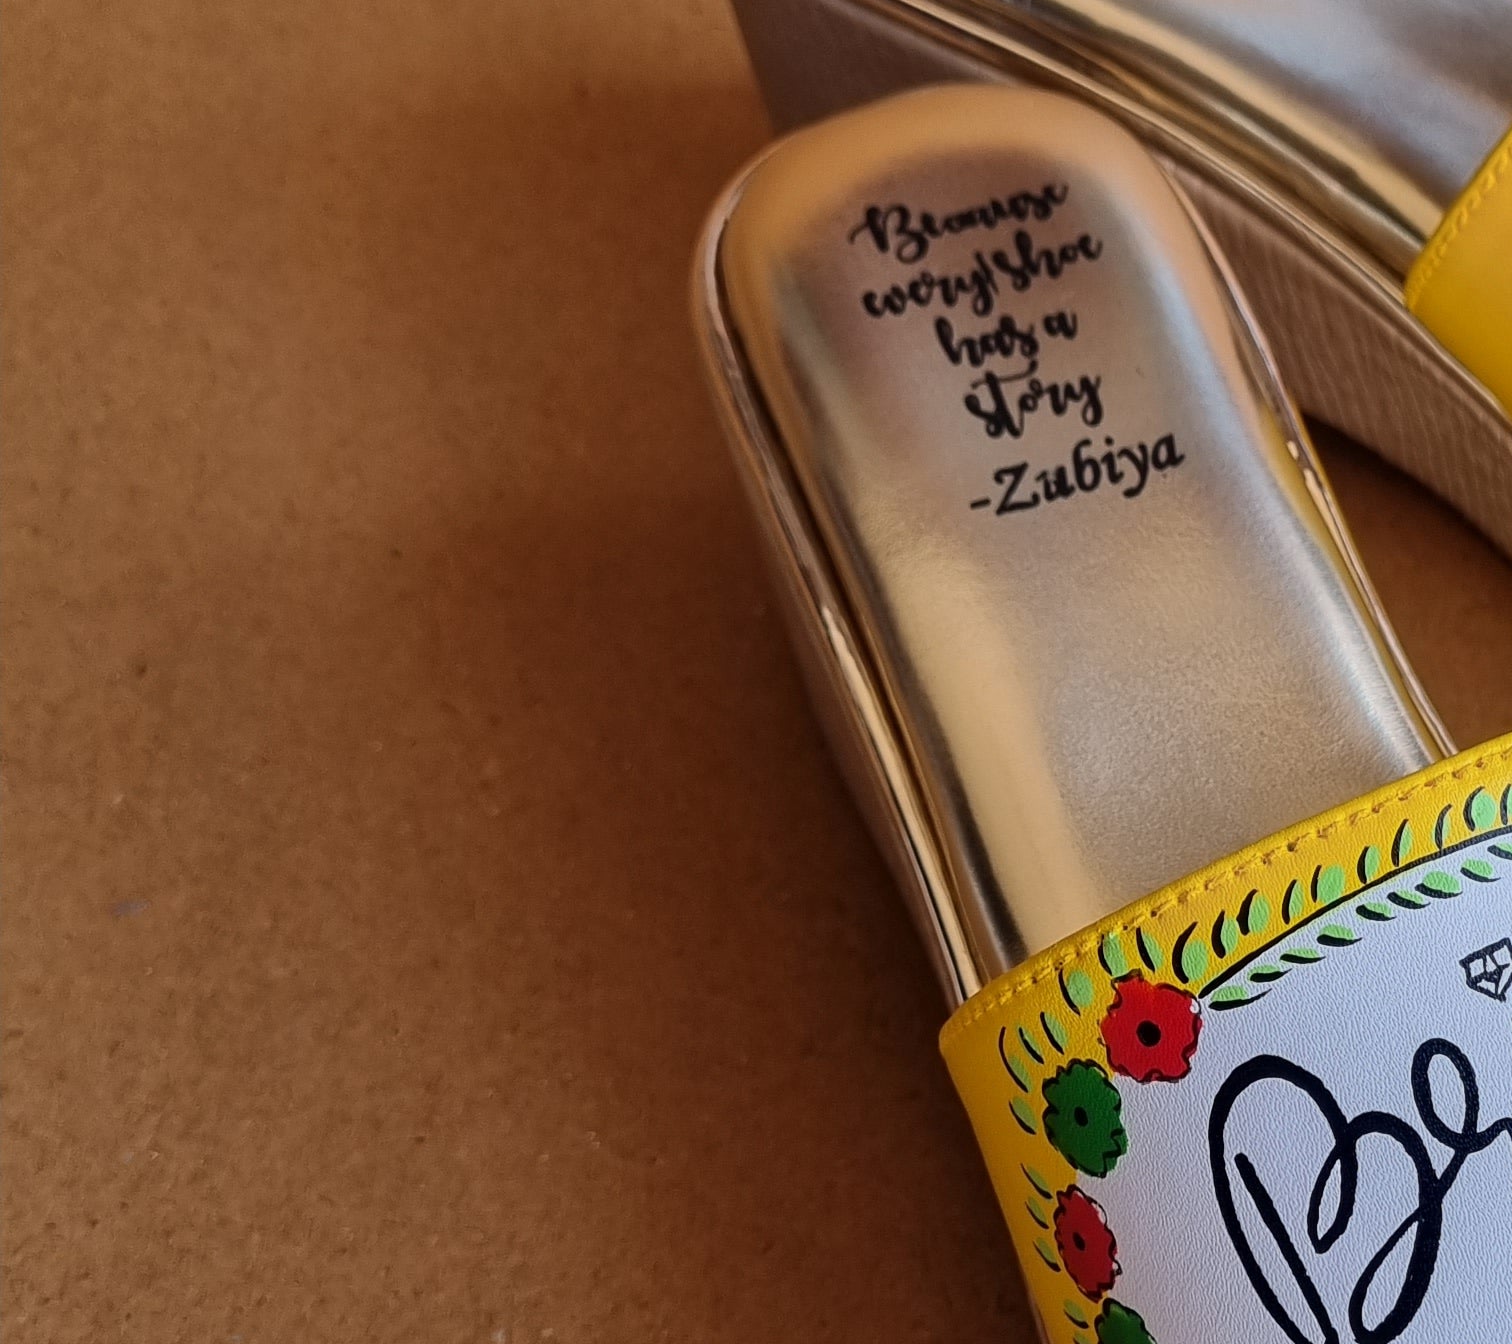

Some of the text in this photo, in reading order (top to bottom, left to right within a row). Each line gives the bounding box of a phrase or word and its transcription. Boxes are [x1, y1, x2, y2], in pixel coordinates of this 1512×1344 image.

[849, 182, 1069, 263] Because
[934, 309, 1079, 368] has a
